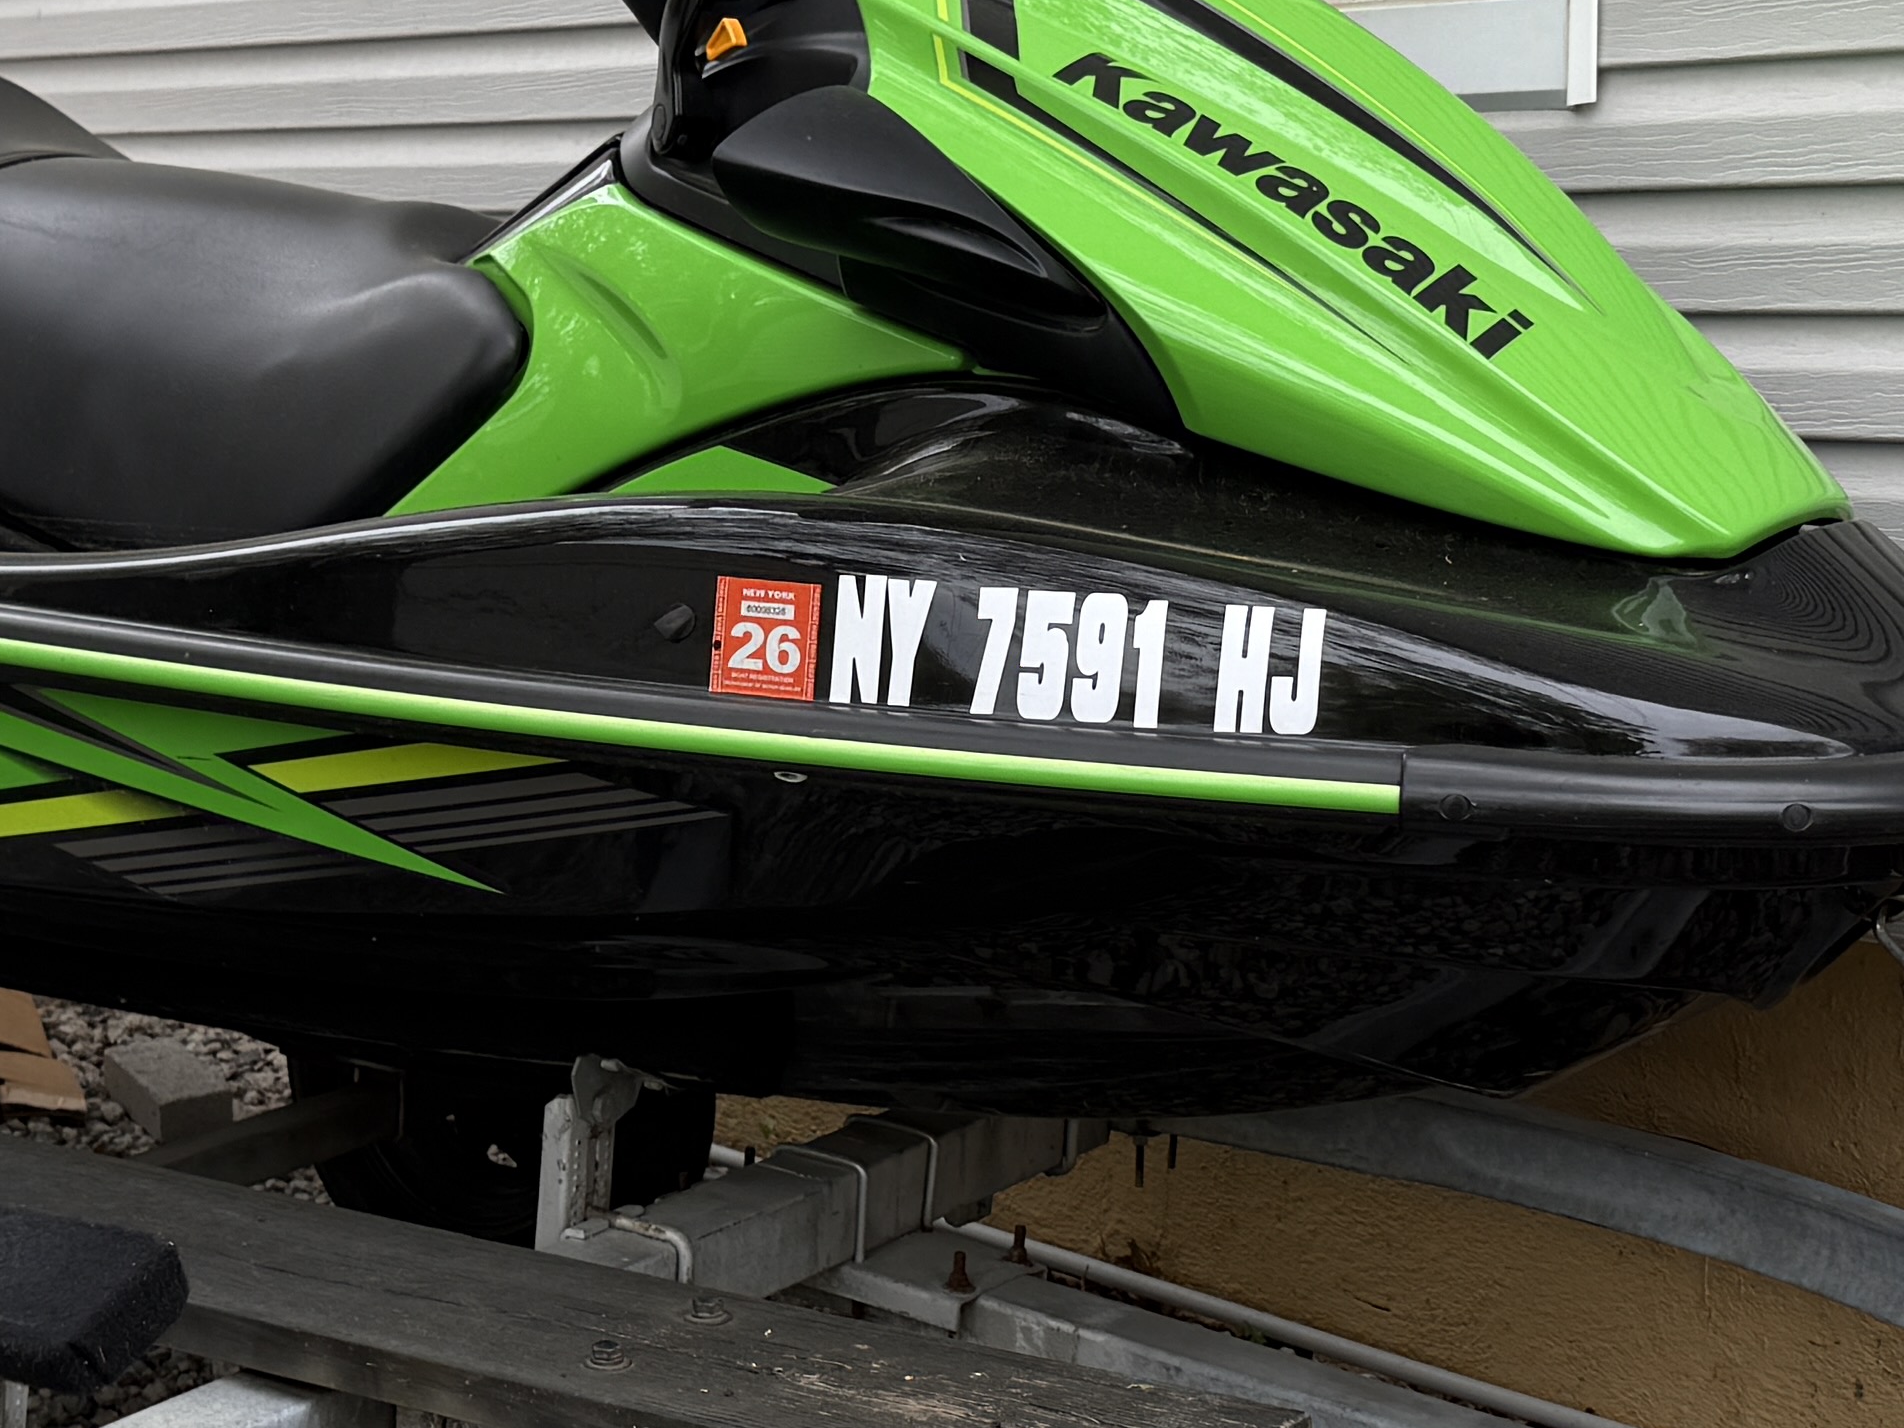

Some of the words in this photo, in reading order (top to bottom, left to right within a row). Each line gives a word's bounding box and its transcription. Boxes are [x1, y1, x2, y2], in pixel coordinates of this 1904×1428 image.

[1052, 52, 1534, 360] Kawasaki
[727, 621, 802, 675] 26
[742, 588, 766, 598] NEW
[767, 590, 796, 601] YORK
[830, 574, 937, 707] NY
[969, 587, 1169, 730] 7591
[1213, 604, 1327, 736] HJ
